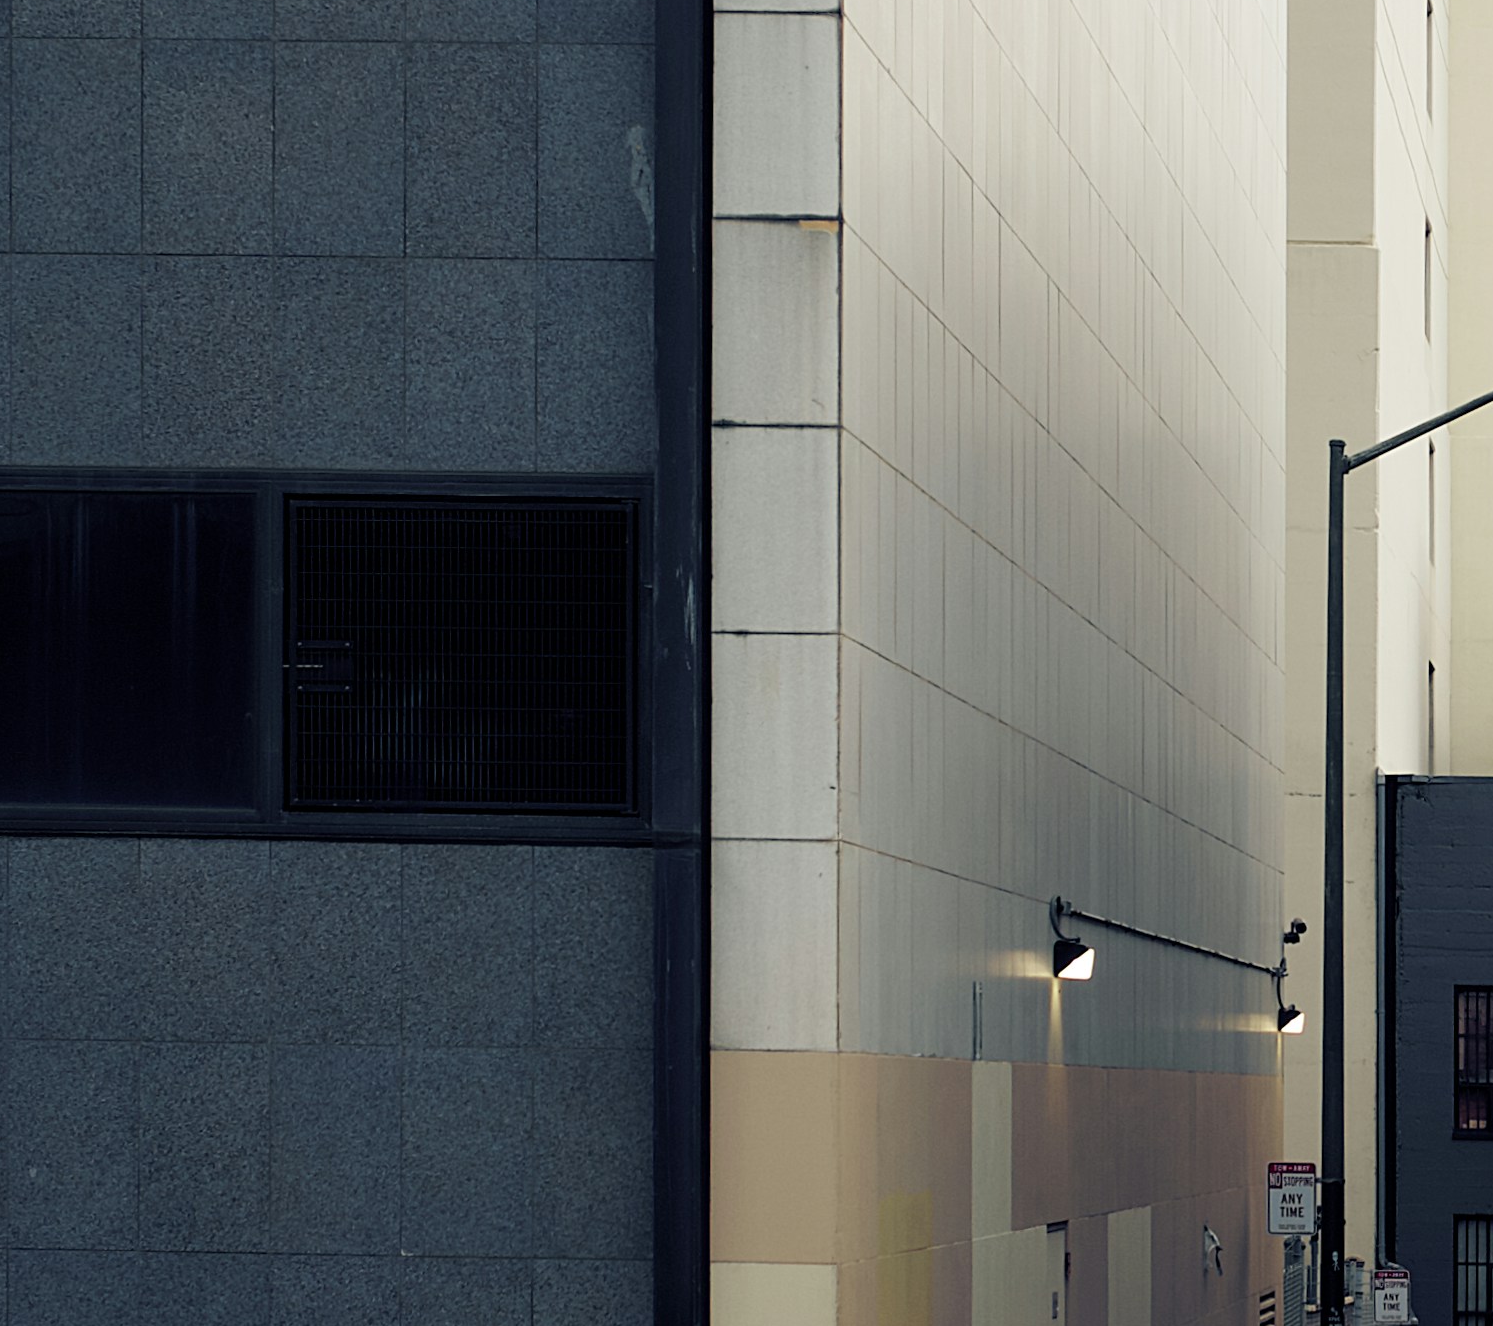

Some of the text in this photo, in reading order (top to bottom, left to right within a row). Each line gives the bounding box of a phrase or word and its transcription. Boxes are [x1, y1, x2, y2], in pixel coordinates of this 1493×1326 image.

[1270, 1172, 1282, 1187] NO
[1281, 1194, 1303, 1204] ANY
[1280, 1206, 1305, 1218] TIME
[1383, 1293, 1399, 1301] ANY
[1383, 1302, 1400, 1311] TIME
